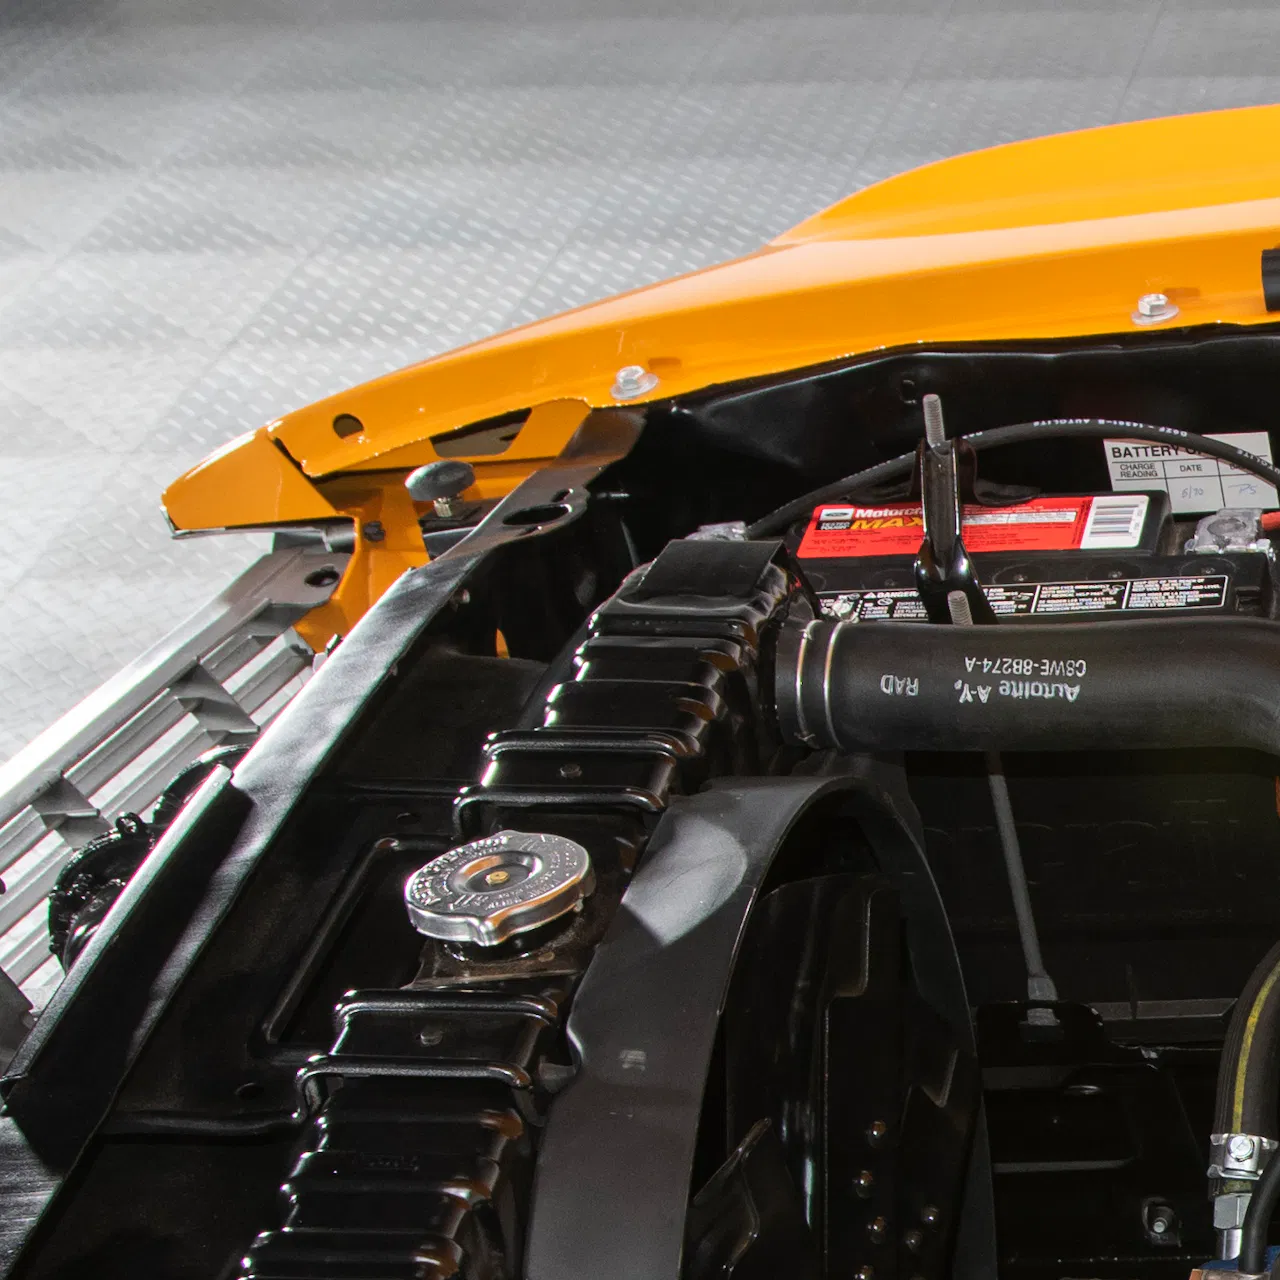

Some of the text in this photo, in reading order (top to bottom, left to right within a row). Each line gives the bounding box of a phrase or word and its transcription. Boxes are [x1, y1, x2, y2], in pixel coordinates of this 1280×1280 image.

[1112, 445, 1180, 459] BATTERY
[1120, 463, 1203, 473] CHARGE DATE
[1120, 470, 1158, 478] READING
[855, 506, 923, 518] Motorcr
[964, 656, 1087, 677] C8WE-8B274-A
[880, 674, 919, 696] RAD
[999, 680, 1081, 703] Autolite
